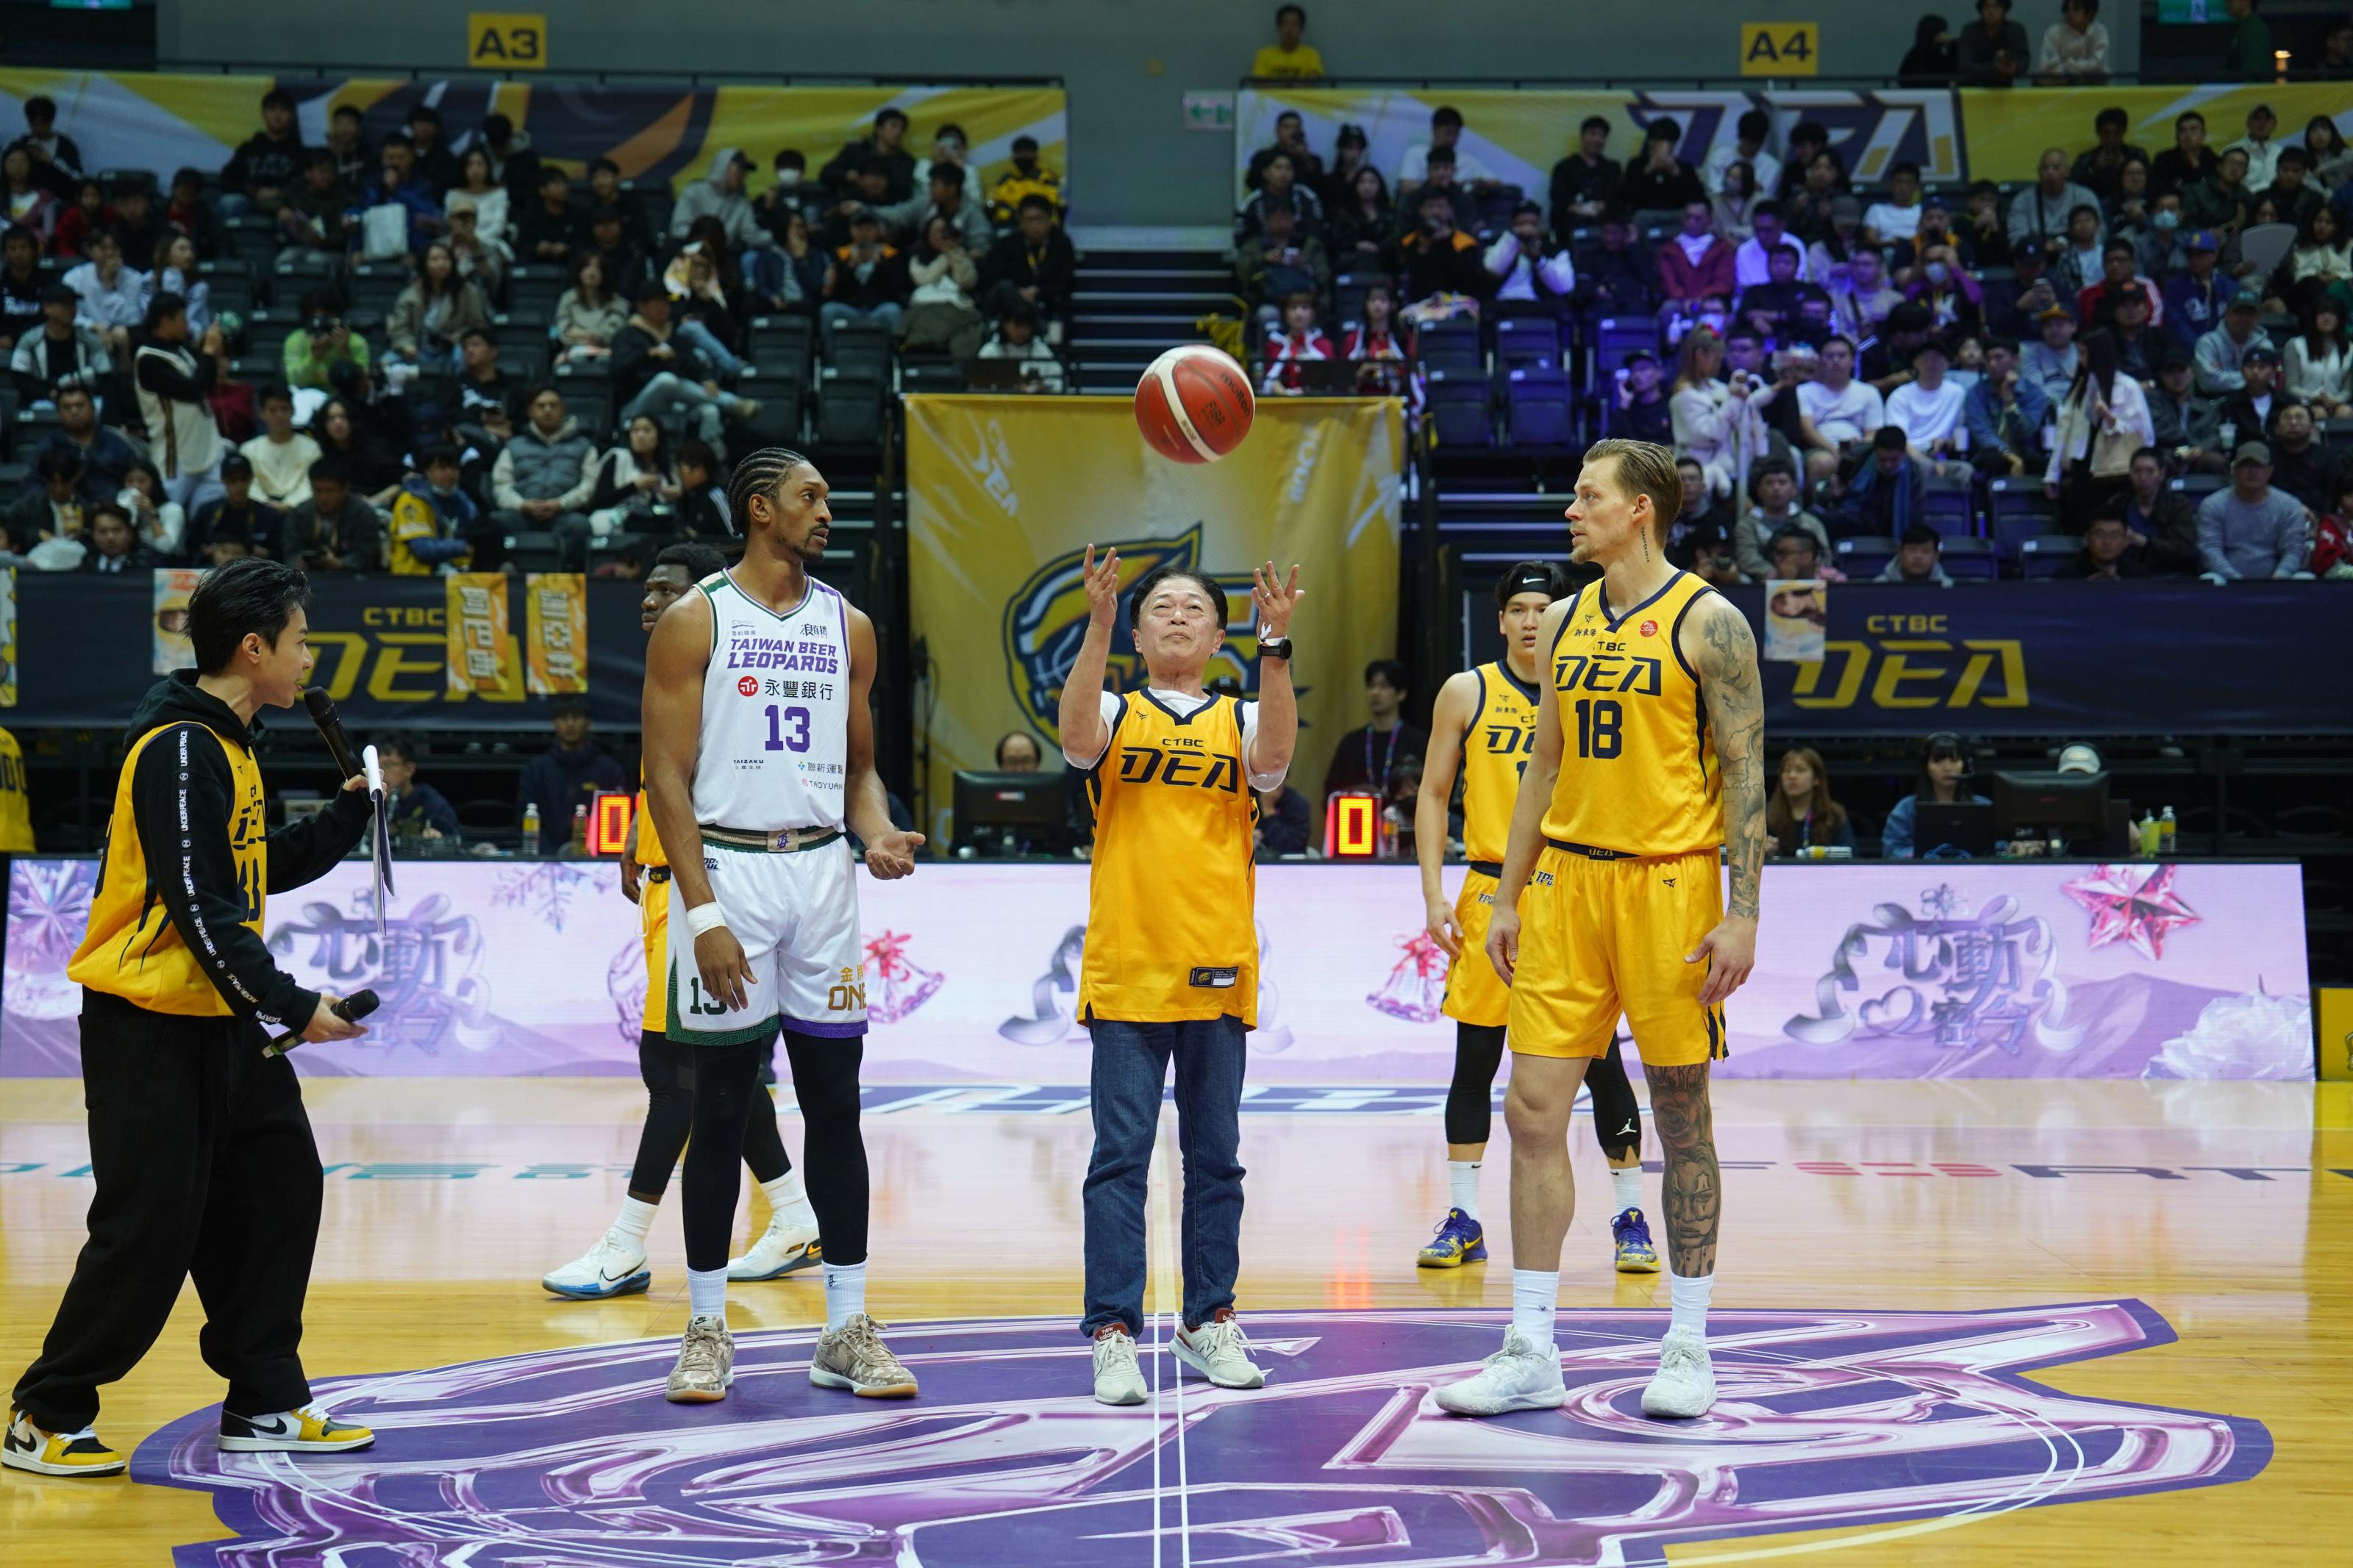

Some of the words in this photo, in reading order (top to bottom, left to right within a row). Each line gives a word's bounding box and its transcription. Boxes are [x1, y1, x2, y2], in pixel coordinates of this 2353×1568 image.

[474, 29, 540, 59] A3
[1747, 30, 1812, 62] A4
[1220, 373, 1250, 418] molten
[363, 606, 445, 626] CTBC
[1866, 615, 1949, 633] CTBC
[731, 638, 795, 654] TAIWAN
[799, 642, 837, 657] BEER
[1592, 641, 1627, 652] TBC
[727, 651, 838, 674] LEOPARDS
[765, 679, 834, 701] 永豐銀行
[765, 704, 810, 753] 13
[1521, 715, 1536, 723] CT
[1575, 698, 1623, 759] 18
[1162, 737, 1204, 748] CTBC
[809, 780, 843, 790] TAOYUAN
[599, 796, 630, 853] 0
[1339, 798, 1373, 854] 0
